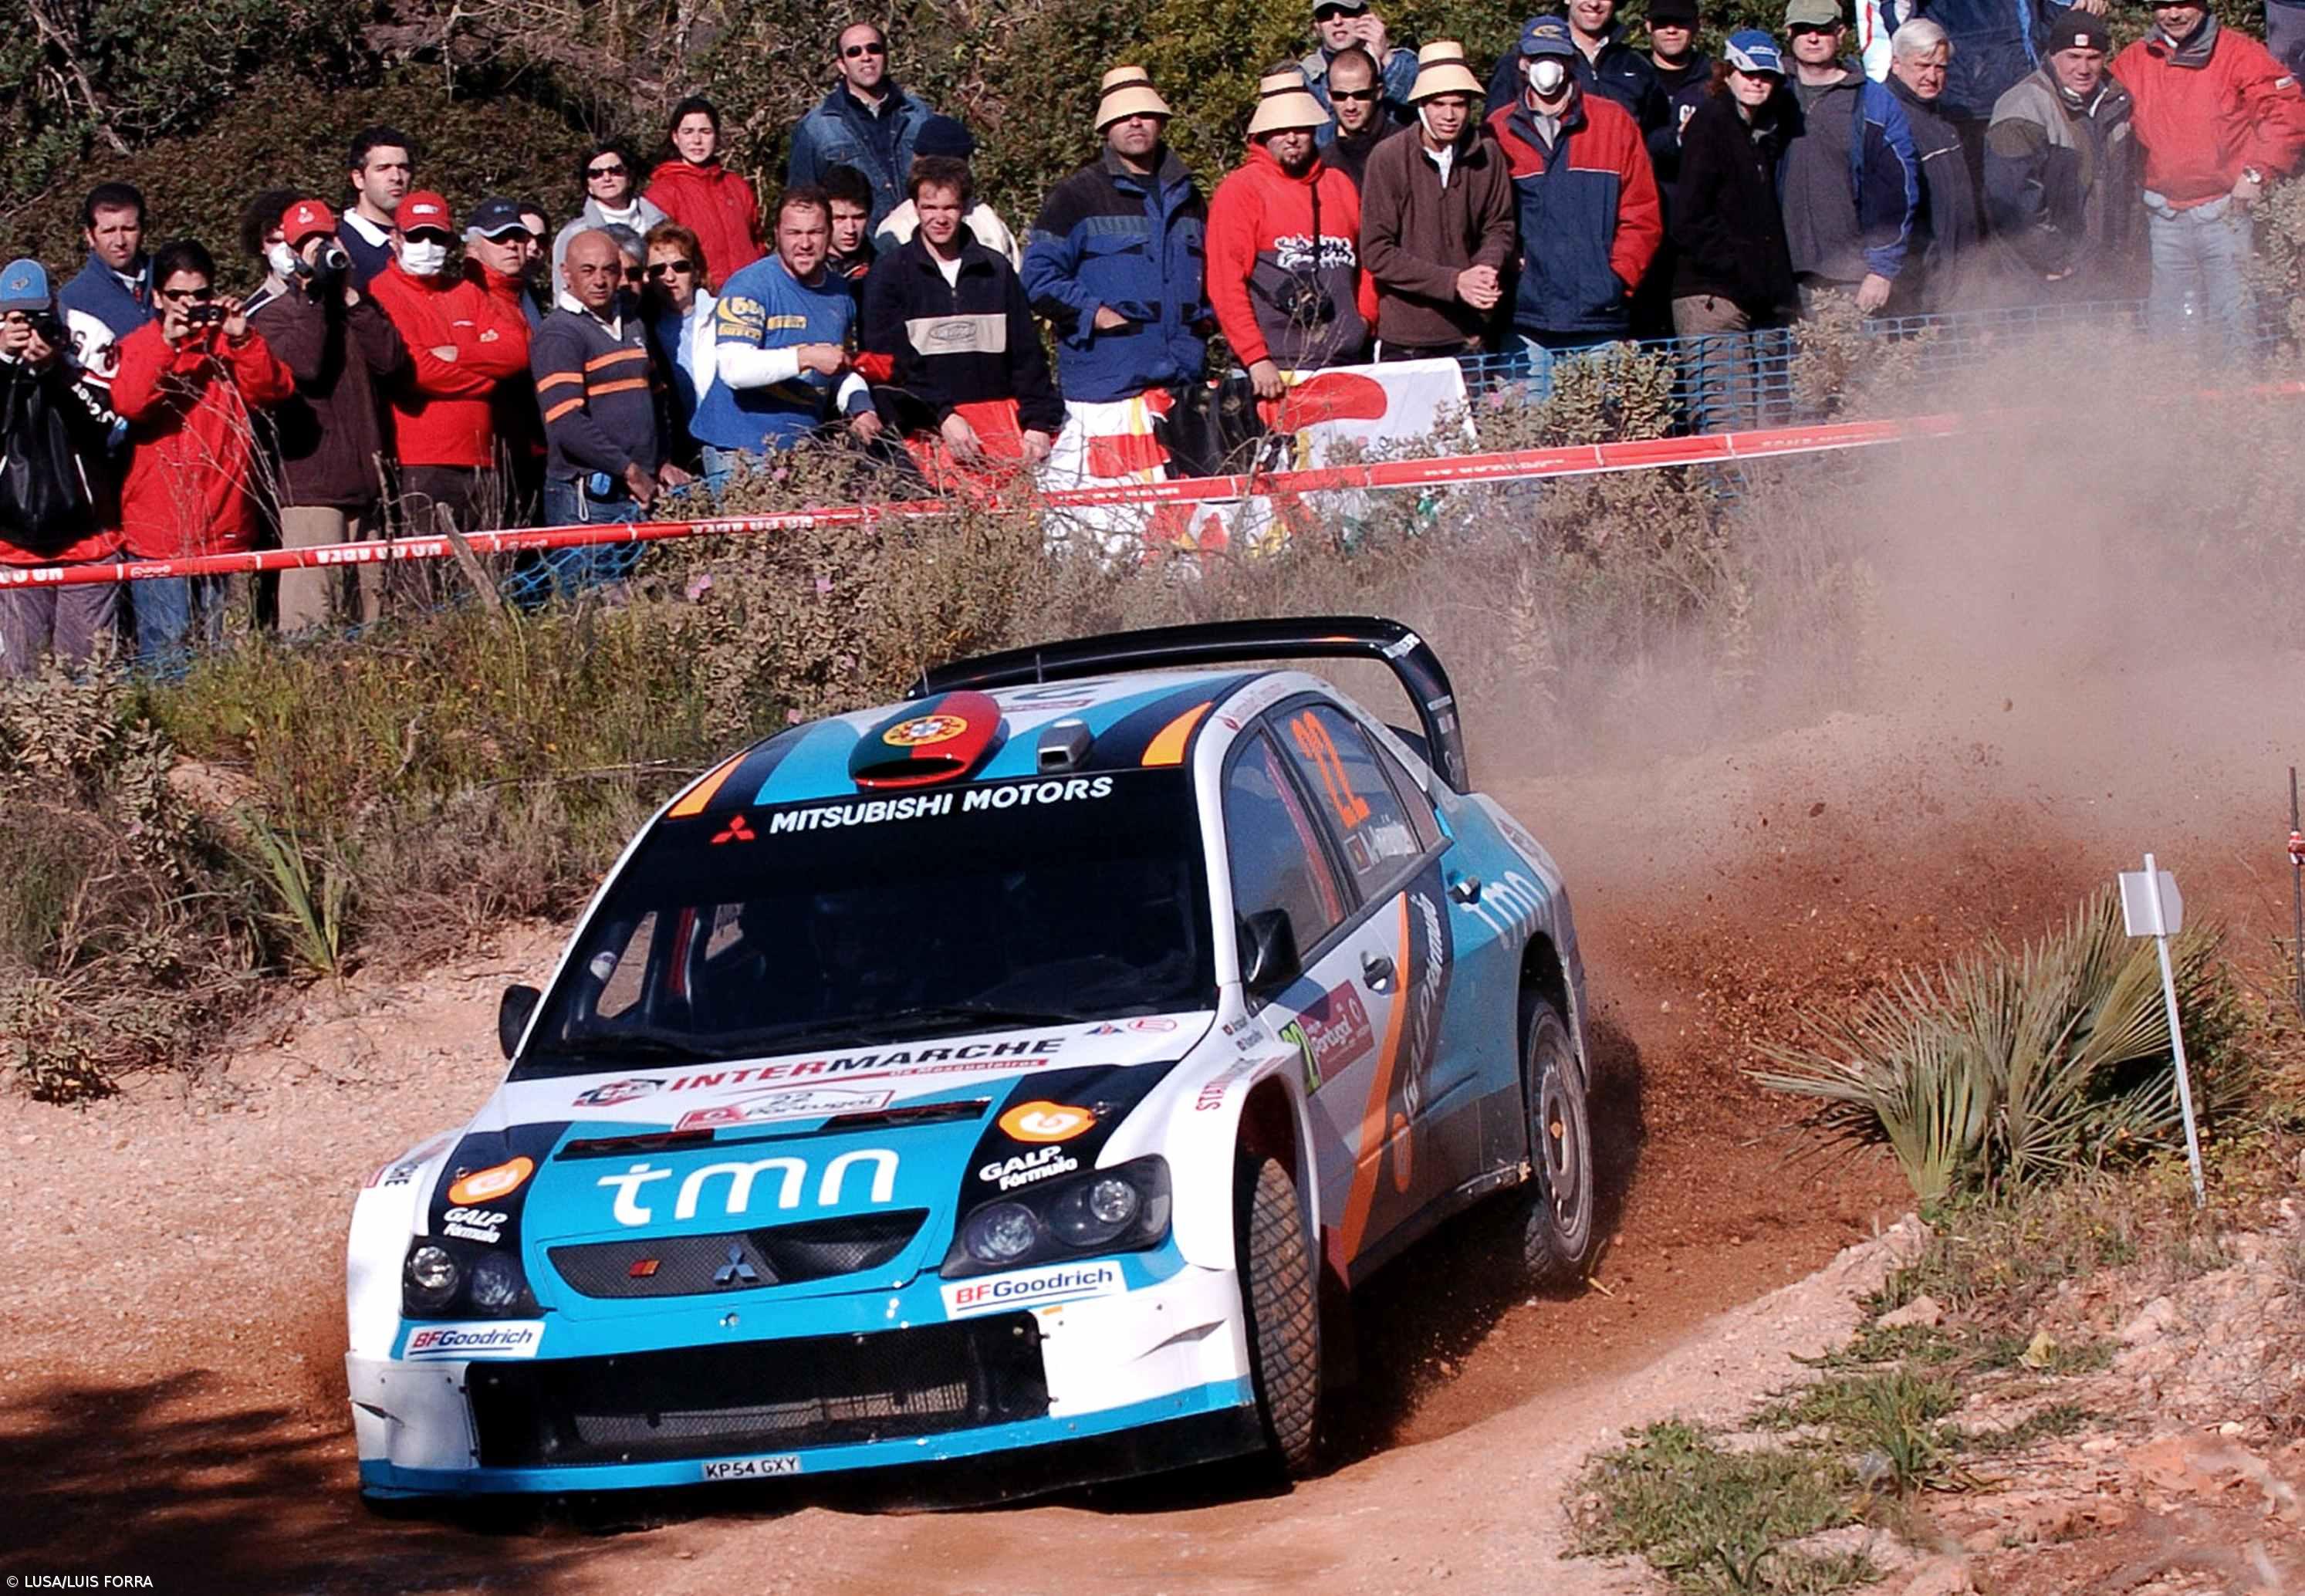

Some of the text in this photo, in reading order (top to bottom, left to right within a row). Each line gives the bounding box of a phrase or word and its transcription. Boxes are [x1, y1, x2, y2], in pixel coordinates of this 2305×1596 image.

[1291, 710, 1370, 828] 22
[770, 776, 1114, 834] MITSUBISHI MOTORS
[670, 1037, 1066, 1091] INTERMARCHE
[770, 1092, 814, 1106] 22
[978, 1145, 1062, 1182] GALP
[597, 1148, 900, 1226] tmn
[444, 1207, 508, 1227] GALP
[955, 1268, 1113, 1304] BFGoodrich
[412, 1328, 533, 1349] BFGoodrich
[706, 1456, 797, 1479] KP54 GXY
